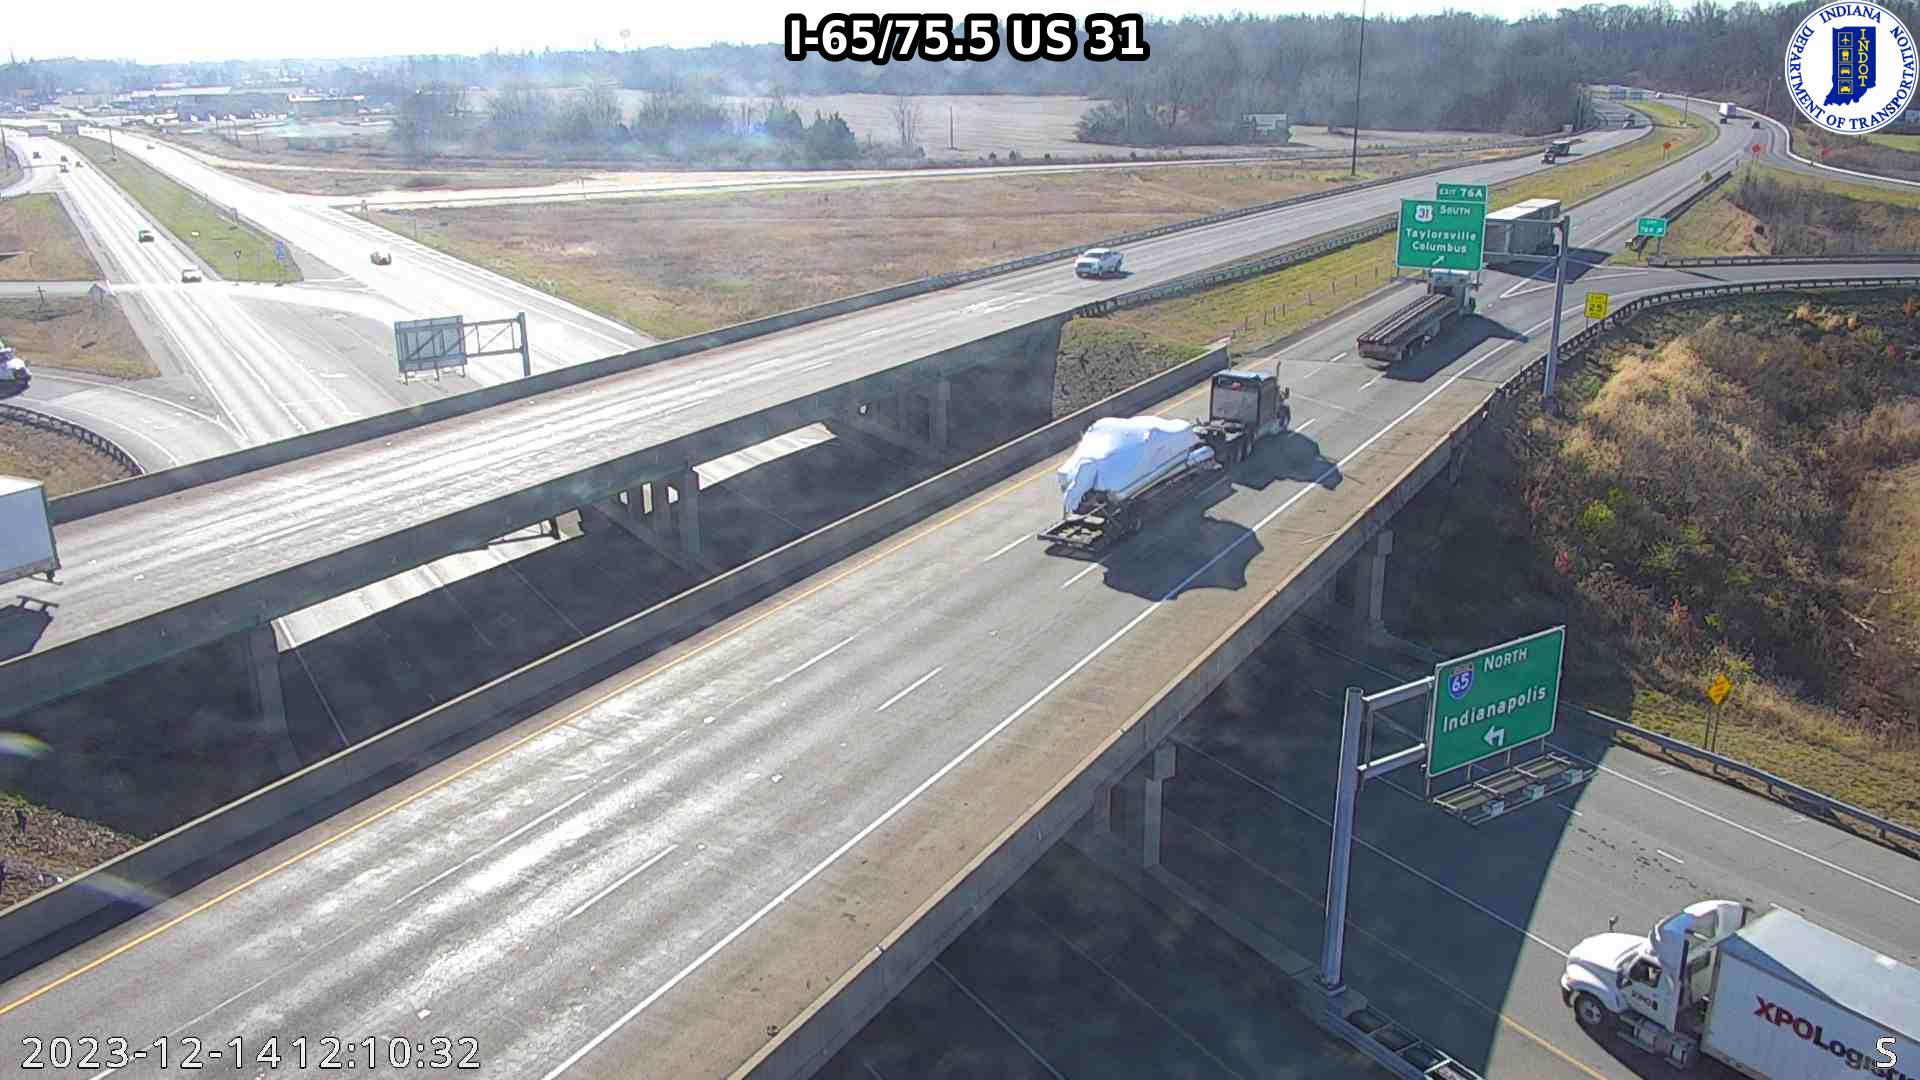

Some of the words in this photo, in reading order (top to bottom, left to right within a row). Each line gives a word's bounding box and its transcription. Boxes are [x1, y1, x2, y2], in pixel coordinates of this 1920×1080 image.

[1460, 188, 1483, 199] 76A
[1418, 207, 1431, 219] 31
[1406, 227, 1477, 242] Taylorsville
[1412, 241, 1467, 254] Columbus
[1483, 647, 1528, 673] NORTH
[1451, 671, 1471, 693] 65
[1443, 684, 1547, 734] Indianapolis
